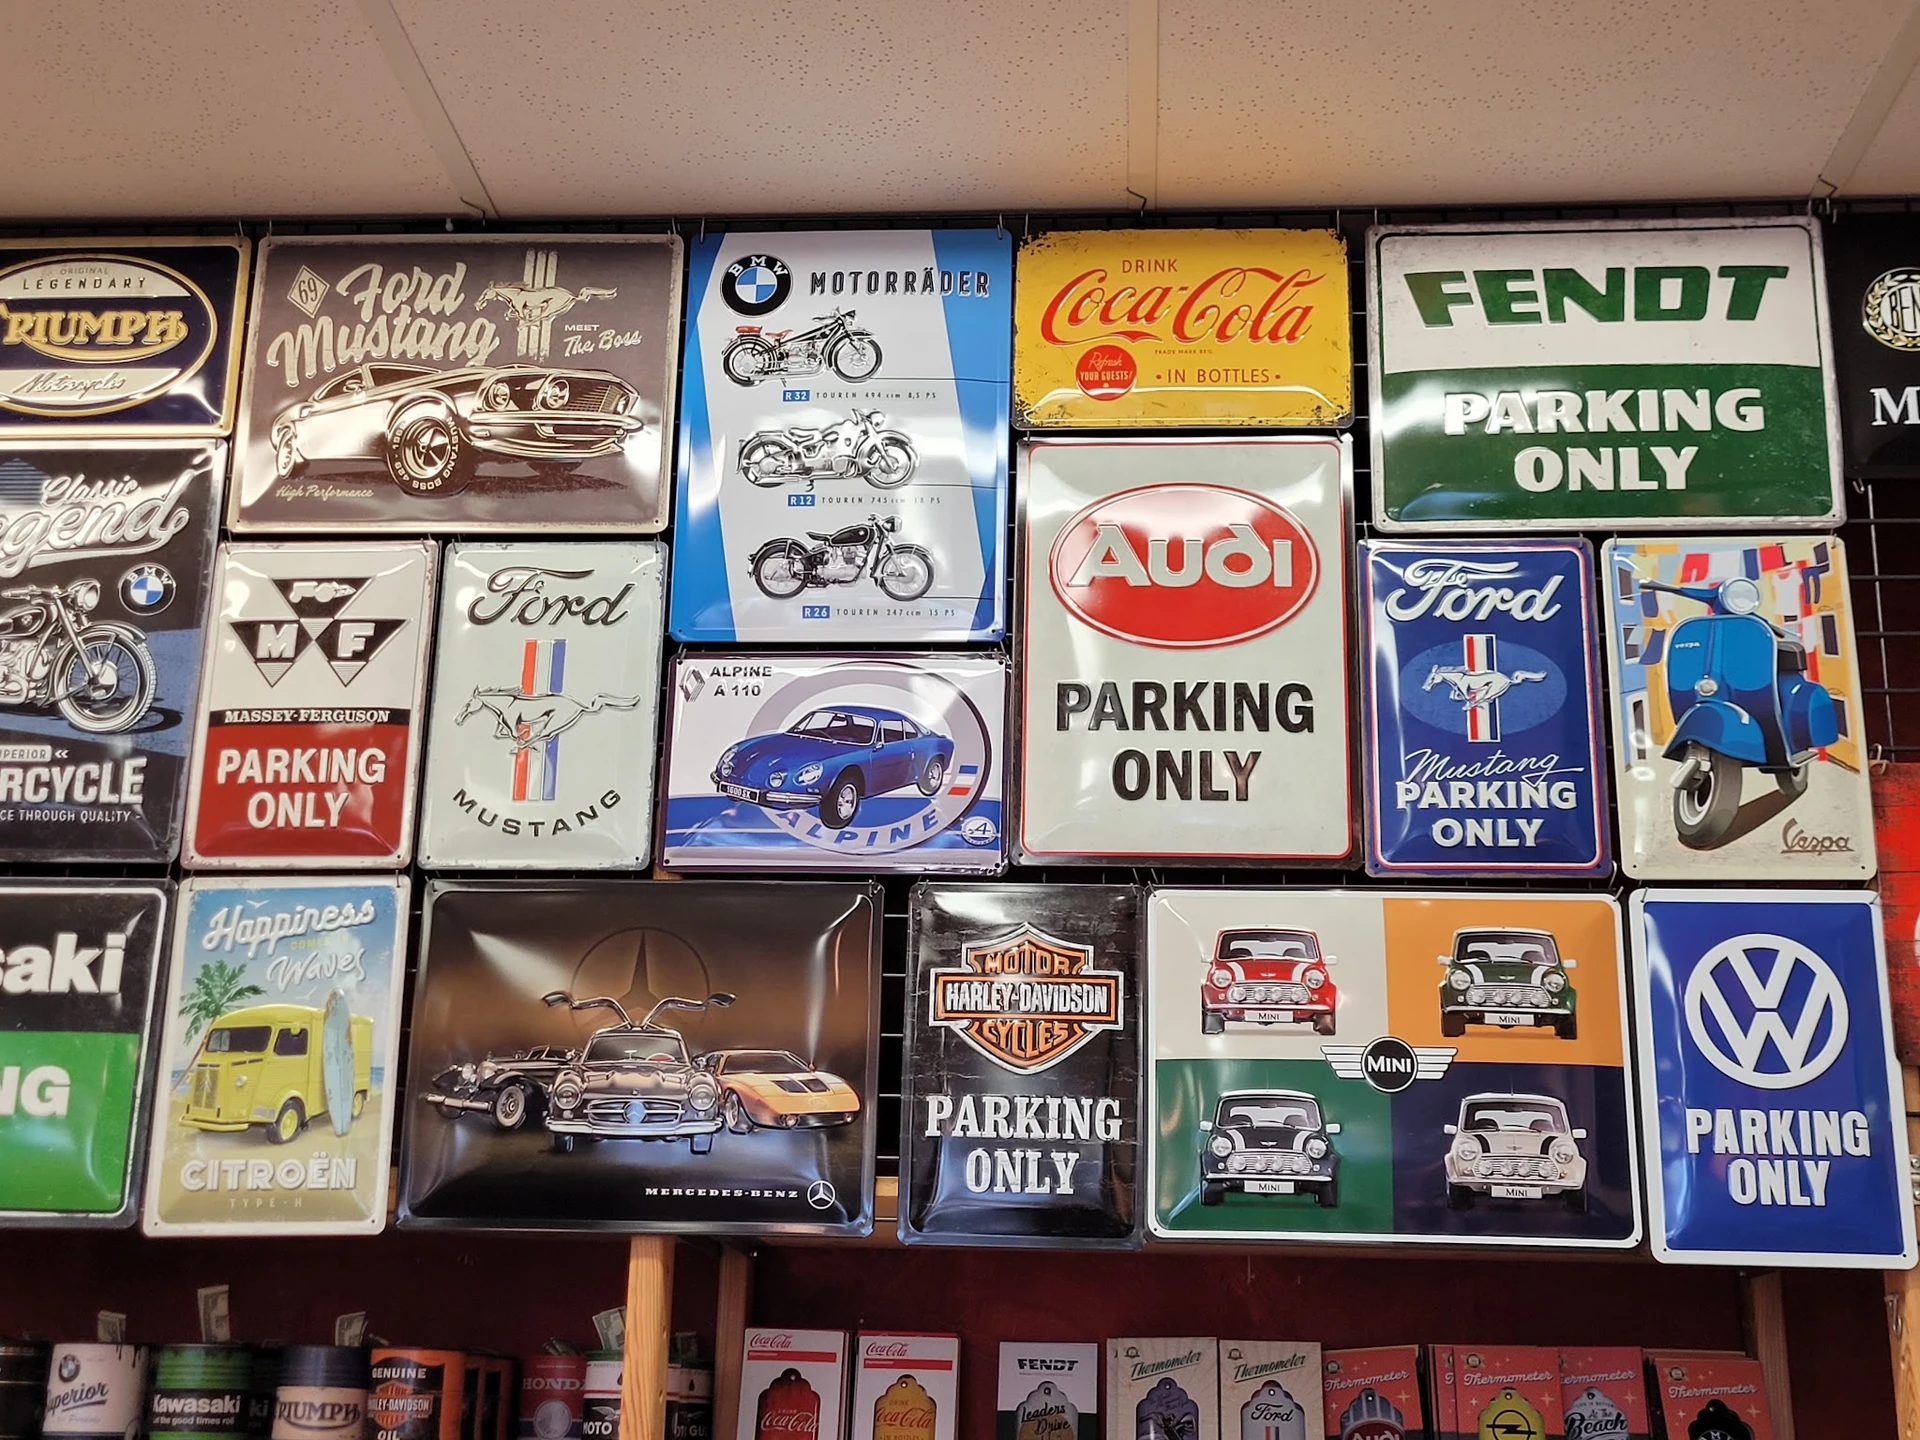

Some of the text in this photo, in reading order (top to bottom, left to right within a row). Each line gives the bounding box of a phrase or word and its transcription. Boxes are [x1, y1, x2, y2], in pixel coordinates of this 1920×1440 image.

[60, 268, 109, 276] ORIGINAL
[728, 256, 788, 277] BMW
[1122, 258, 1178, 273] DRINK
[23, 277, 146, 290] LEGENDARY
[297, 277, 319, 306] 69
[336, 262, 467, 323] Ford
[809, 266, 991, 298] MOTORRÄDER
[1040, 267, 1327, 347] Coca-Cola
[1404, 265, 1789, 329] FENDT
[0, 304, 188, 356] RIUMPH
[564, 324, 600, 332] MEET
[267, 305, 499, 387] Mustang
[563, 329, 643, 357] The Boss
[1080, 370, 1133, 381] YOUR GUESTS!
[1088, 351, 1123, 371] Refresh
[12, 371, 126, 399] Motorcycles
[1167, 368, 1270, 384] IN BOTTLES
[1444, 387, 1765, 436] PARKING
[446, 416, 460, 478] MUSTANG
[1513, 445, 1700, 493] ONLY
[40, 473, 142, 508] Classic
[275, 483, 374, 501] High Performance
[412, 477, 443, 491] BOSS
[822, 496, 863, 504] TOUREN
[1067, 522, 1292, 588] Audi
[127, 566, 173, 586] BMW
[1385, 558, 1565, 622] Ford
[467, 565, 635, 626] Ford
[836, 608, 880, 616] TOUREN
[944, 608, 956, 616] PS
[256, 622, 376, 660] M F
[709, 665, 773, 678] ALPINE
[713, 684, 762, 697] A 110
[224, 708, 391, 724] MASSEY-FERGUSON
[1055, 680, 1315, 733] PARKING
[0, 749, 47, 760] PERIOR
[216, 747, 387, 785] PARKING
[1404, 748, 1585, 788] Mustang
[0, 757, 148, 804] RCYCLE
[1111, 748, 1262, 802] ONLY
[1395, 780, 1578, 810] PARKING
[18, 809, 76, 822] THROUGH
[80, 809, 132, 824] QUALITY
[247, 791, 349, 829] ONLY
[452, 788, 621, 837] MUSTANG
[776, 807, 939, 847] ALPINE
[1431, 818, 1545, 848] ONLY
[1781, 817, 1853, 856] Vespa
[201, 899, 376, 959] Happiness
[0, 931, 127, 994] aki
[266, 946, 367, 993] Waves
[984, 941, 1071, 976] MOTOR
[945, 981, 1108, 1014] HARLEY-DAVIDSON
[983, 1020, 1070, 1059] CYCLES
[1366, 1055, 1412, 1075] MINI
[925, 1094, 1123, 1142] PARKING
[1685, 1107, 1871, 1157] PARKING
[179, 1152, 358, 1193] CITROËN
[965, 1149, 1080, 1195] ONLY
[1727, 1157, 1832, 1207] ONLY
[644, 1186, 800, 1199] MERCEDES-BENZ
[371, 1367, 427, 1379] GENUINE
[1017, 1358, 1079, 1372] FENDT
[1130, 1350, 1202, 1379] Thermometer
[1234, 1353, 1306, 1381] Thermometer
[1464, 1371, 1553, 1386] Thermometer
[1325, 1370, 1409, 1391] Thermometer
[1668, 1384, 1757, 1398] Thermometer
[276, 1401, 361, 1427] RIUMPH
[371, 1397, 431, 1411] LEY-DAVIDSON
[1021, 1401, 1066, 1423] Leaders
[1251, 1402, 1294, 1423] Ford
[172, 1416, 194, 1426] good
[196, 1416, 221, 1425] times
[583, 1421, 613, 1435] MOTO
[1035, 1417, 1071, 1436] Drive
[1564, 1412, 1628, 1440] Beach
